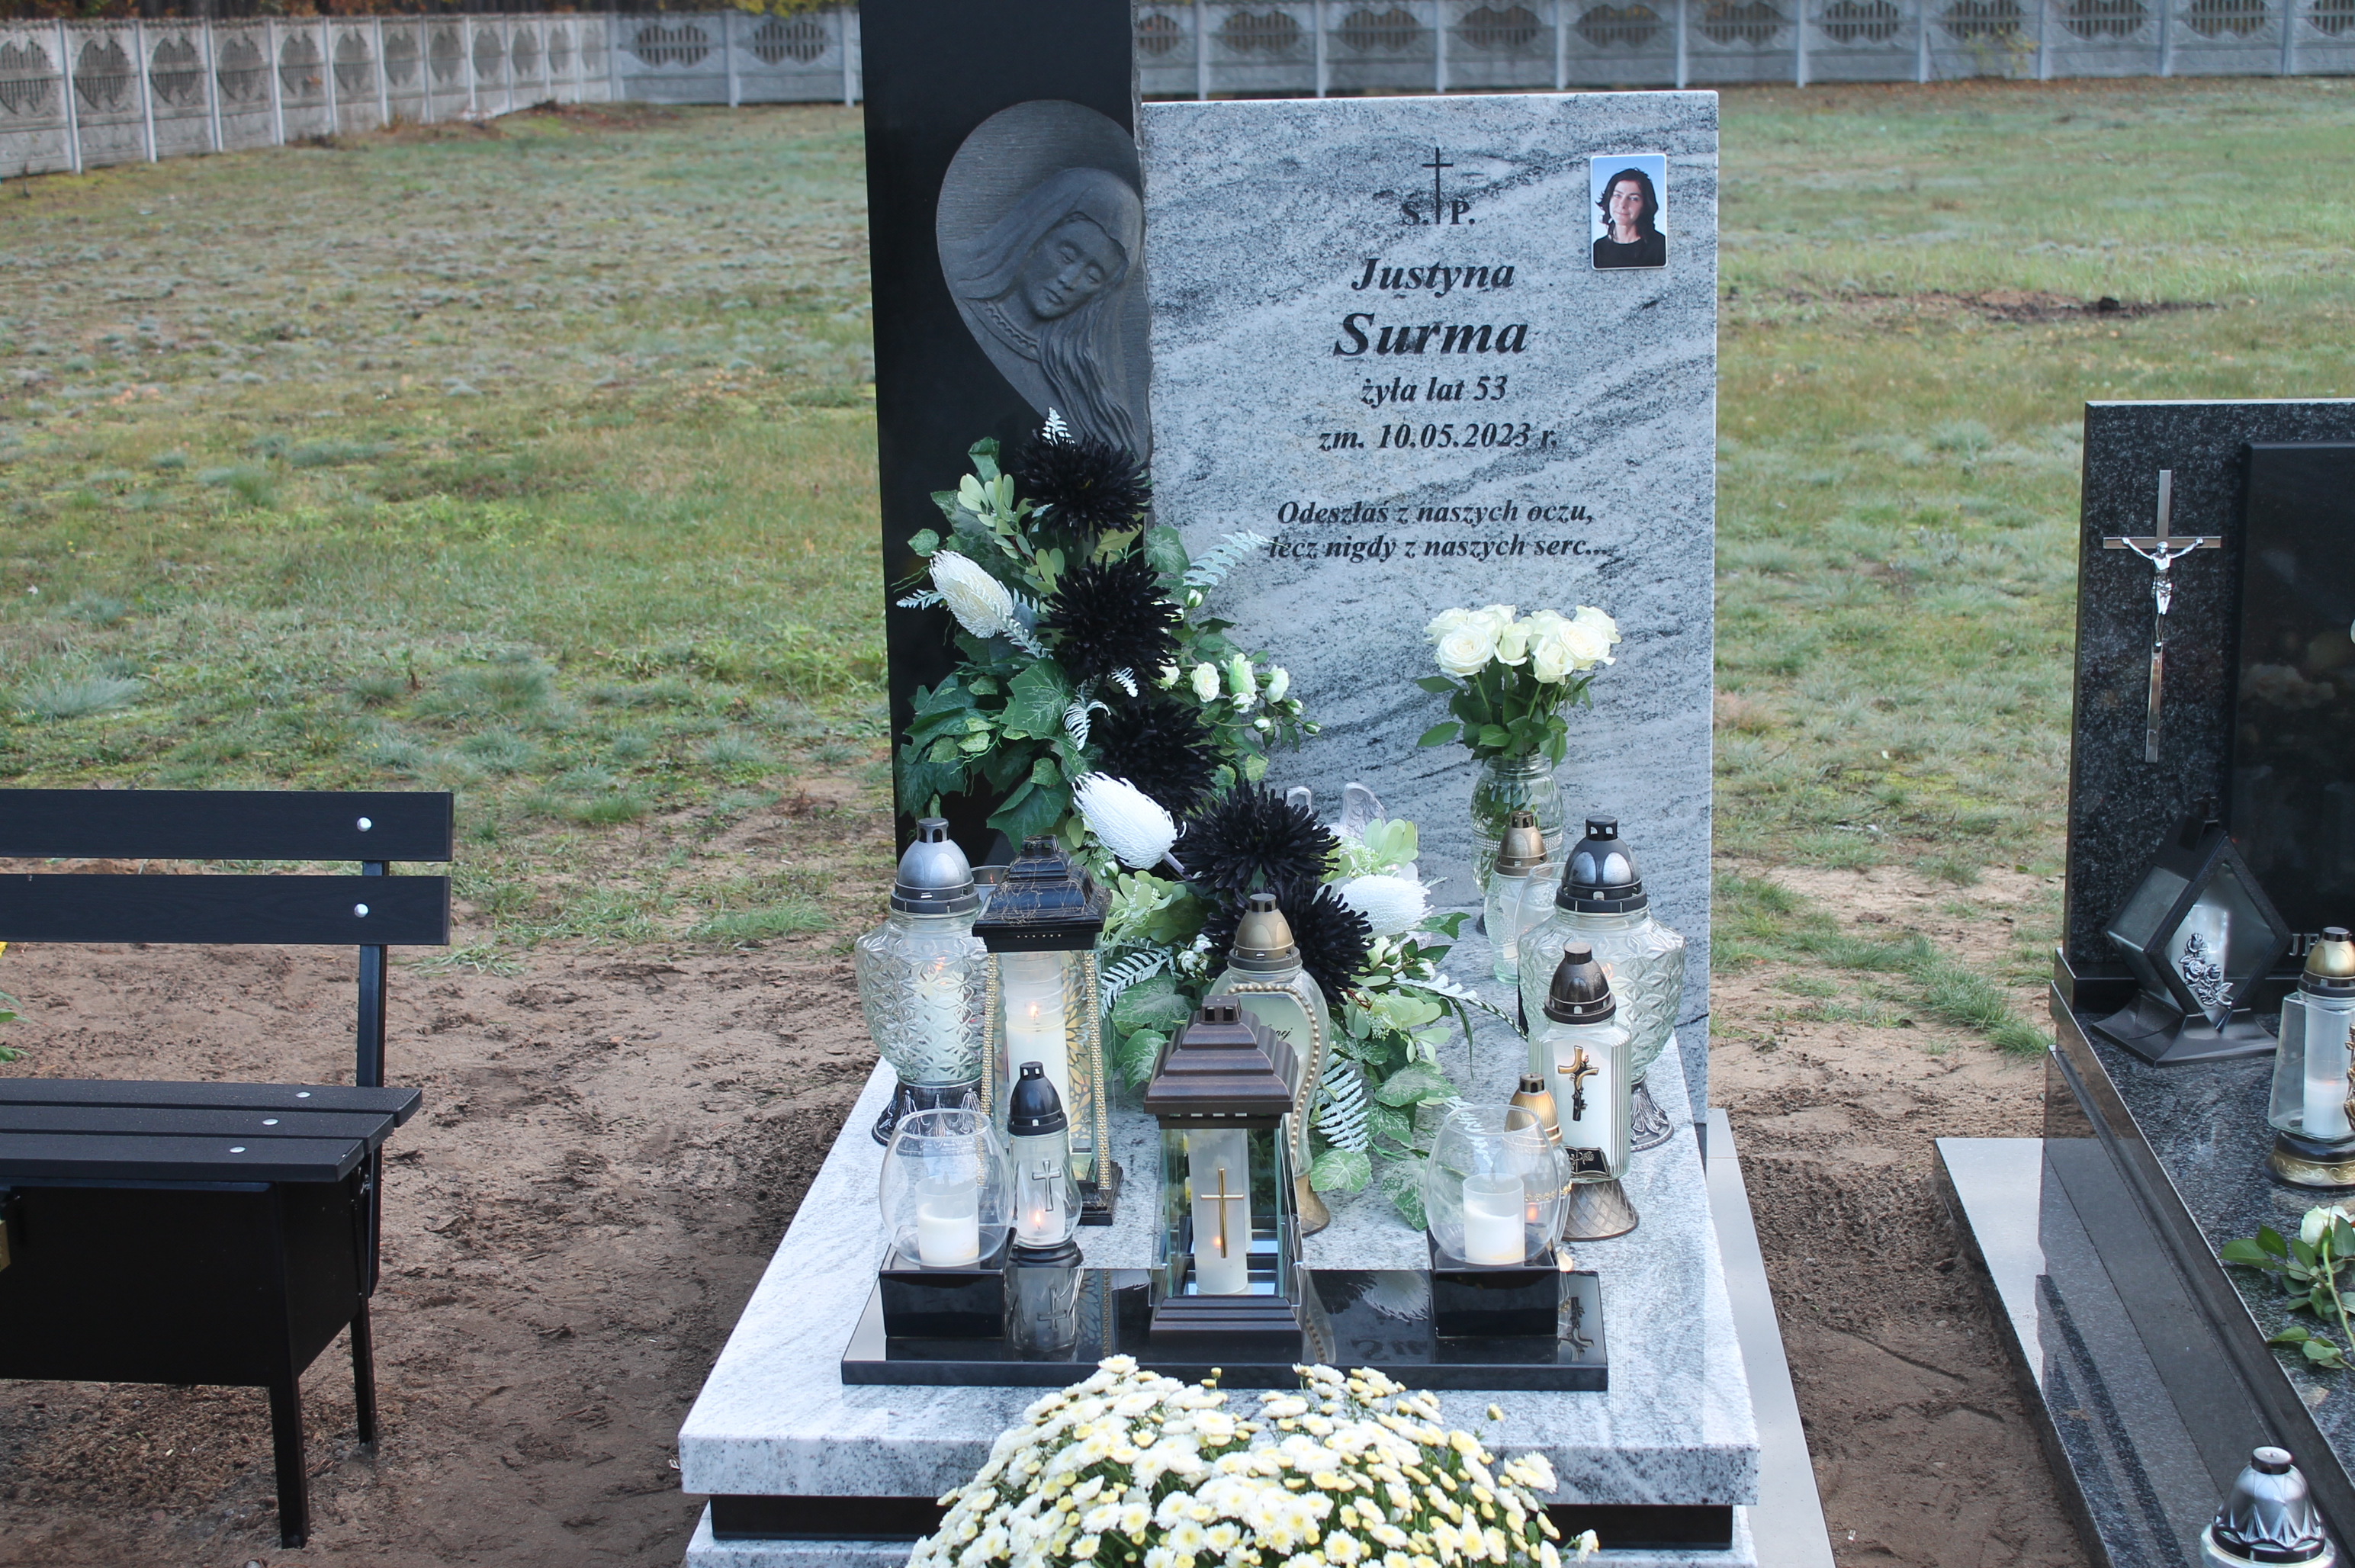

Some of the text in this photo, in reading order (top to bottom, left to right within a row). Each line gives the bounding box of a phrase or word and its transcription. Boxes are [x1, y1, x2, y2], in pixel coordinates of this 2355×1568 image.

[1449, 199, 1476, 226] P.
[1351, 257, 1516, 299] Justyna
[1334, 312, 1529, 356] Surma
[1360, 374, 1508, 410] żyła lat 53
[1318, 430, 1365, 452] zm.
[1377, 422, 1531, 449] 10.05.2023
[1277, 499, 1593, 529] Odeszłaś z naszych oczu,
[1269, 533, 1608, 564] lecz nigdy z naszych serc...
